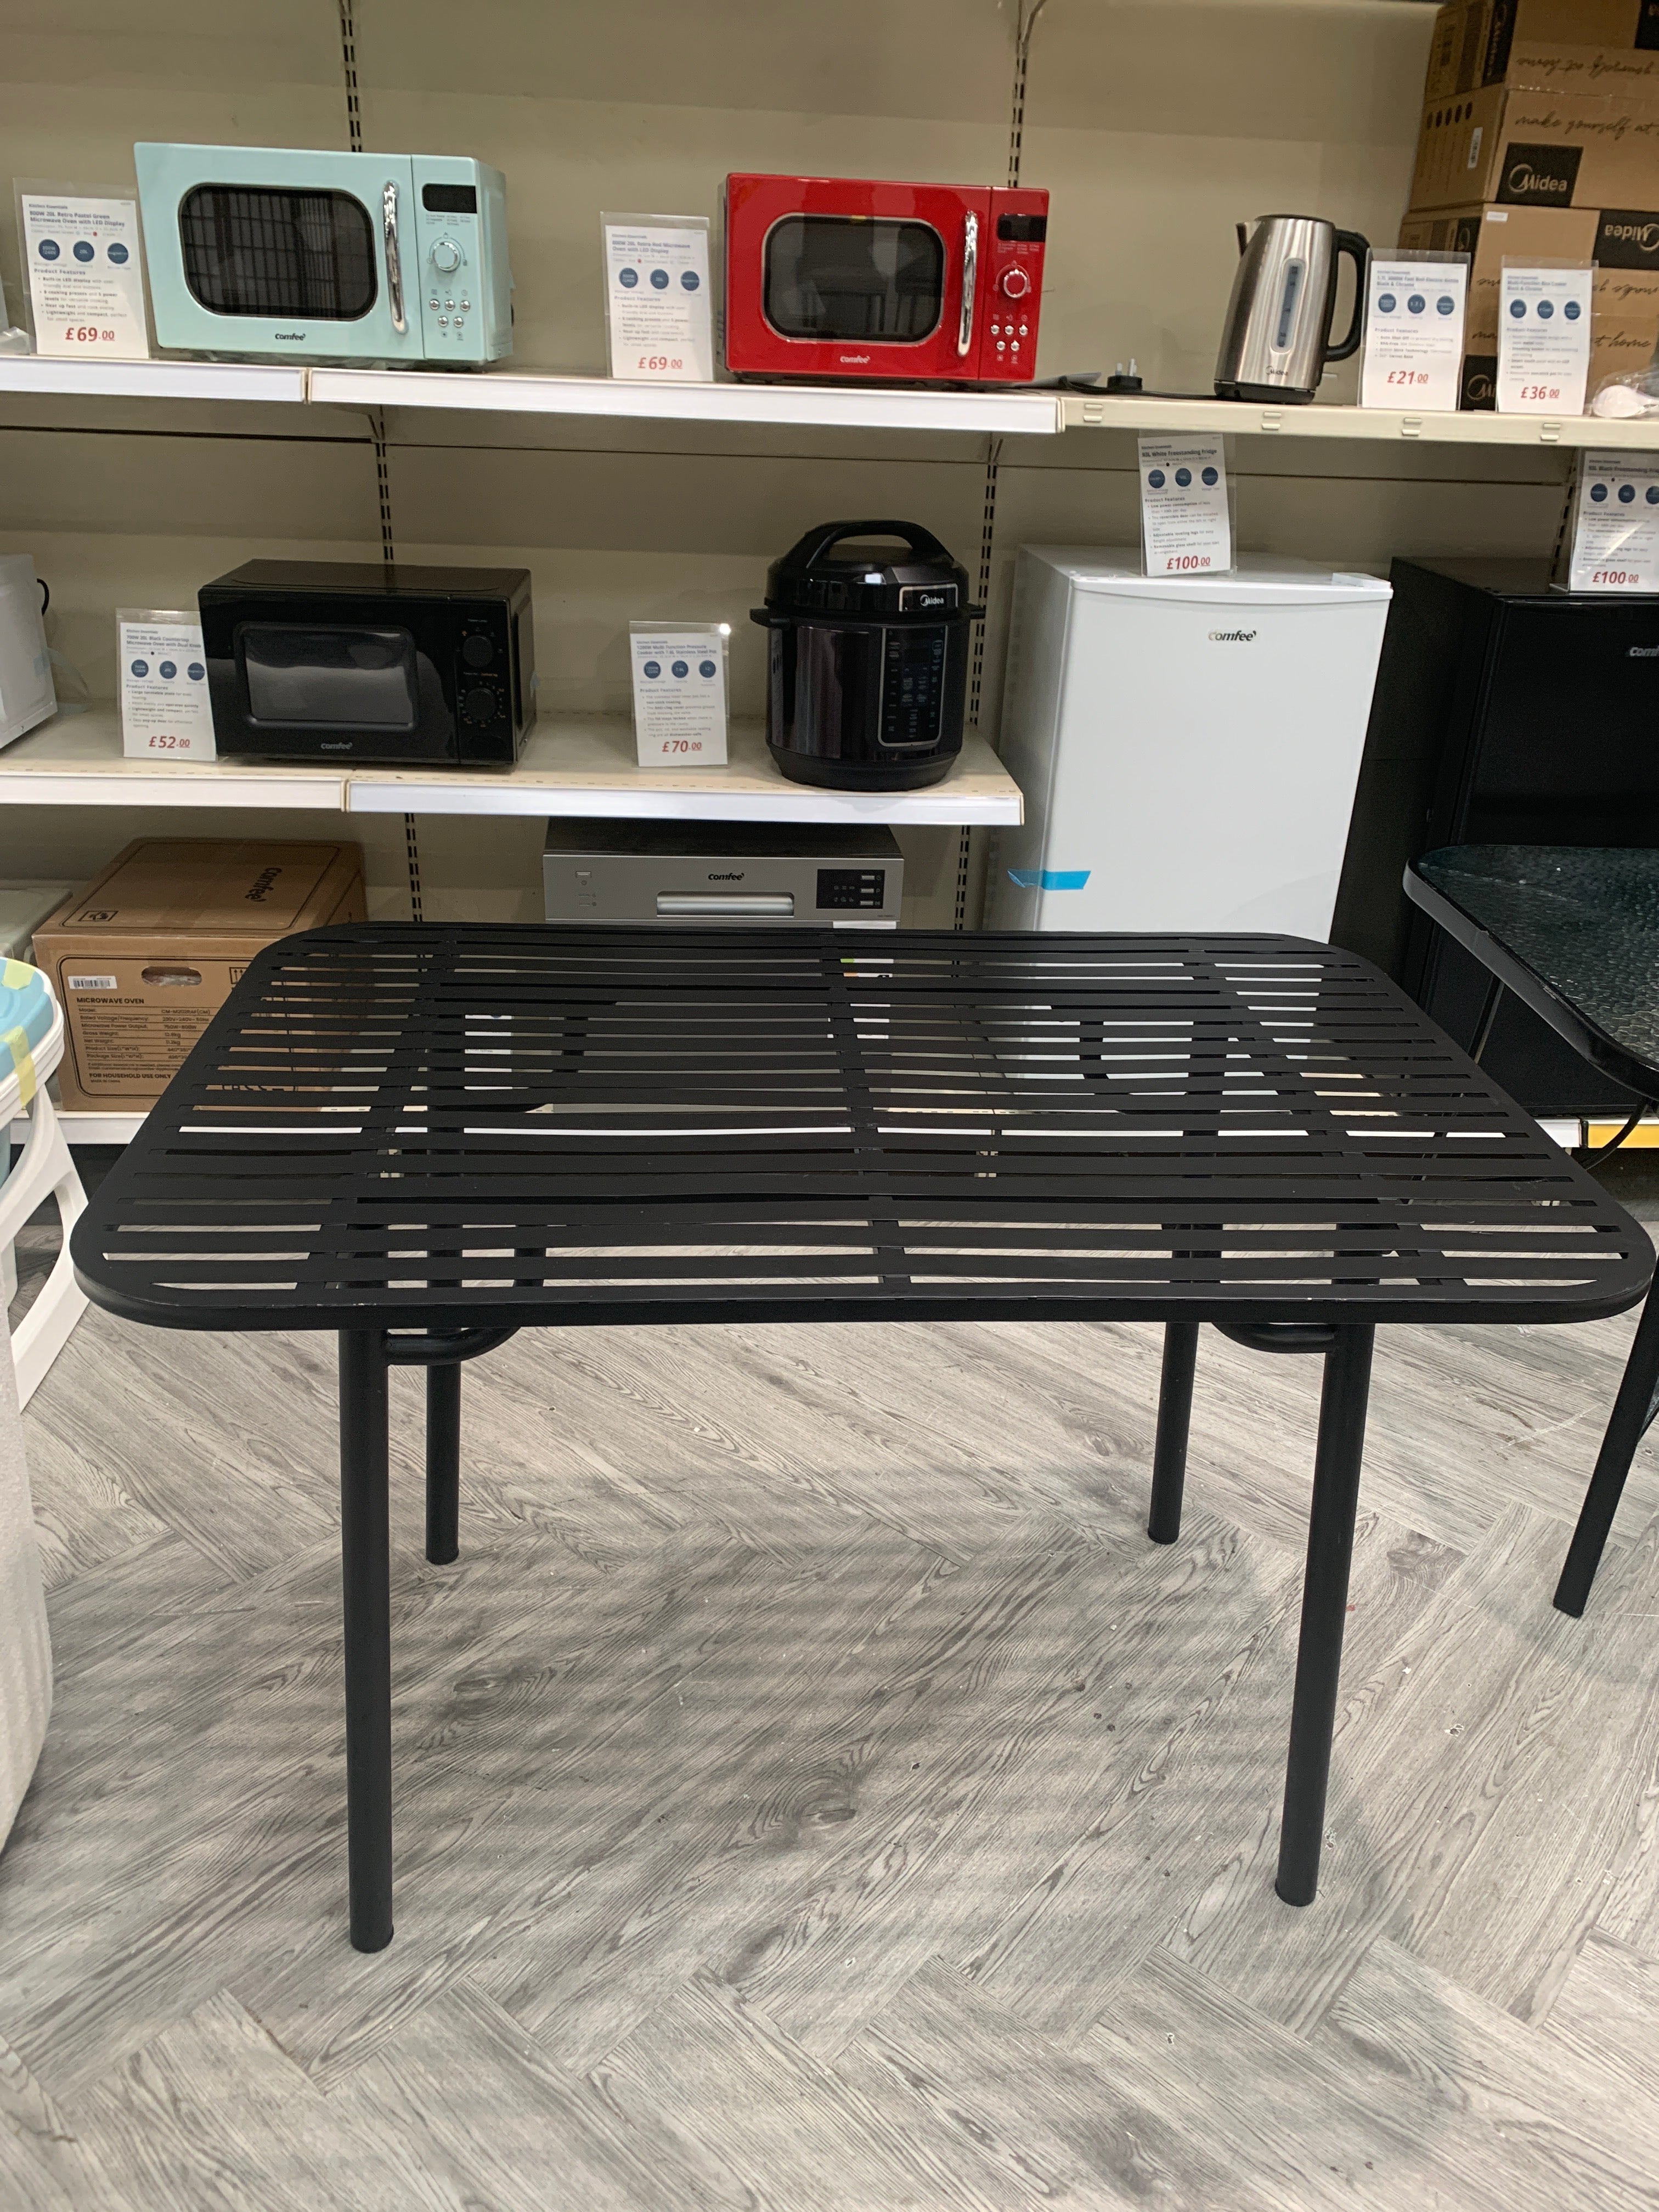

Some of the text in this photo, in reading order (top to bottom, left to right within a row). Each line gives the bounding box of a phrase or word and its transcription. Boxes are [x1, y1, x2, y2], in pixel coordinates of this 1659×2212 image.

[1509, 164, 1567, 193] Midea
[1605, 223, 1659, 251] Midea
[1265, 365, 1288, 375] Midea
[920, 594, 944, 606] Midea
[149, 736, 190, 748] £52.00
